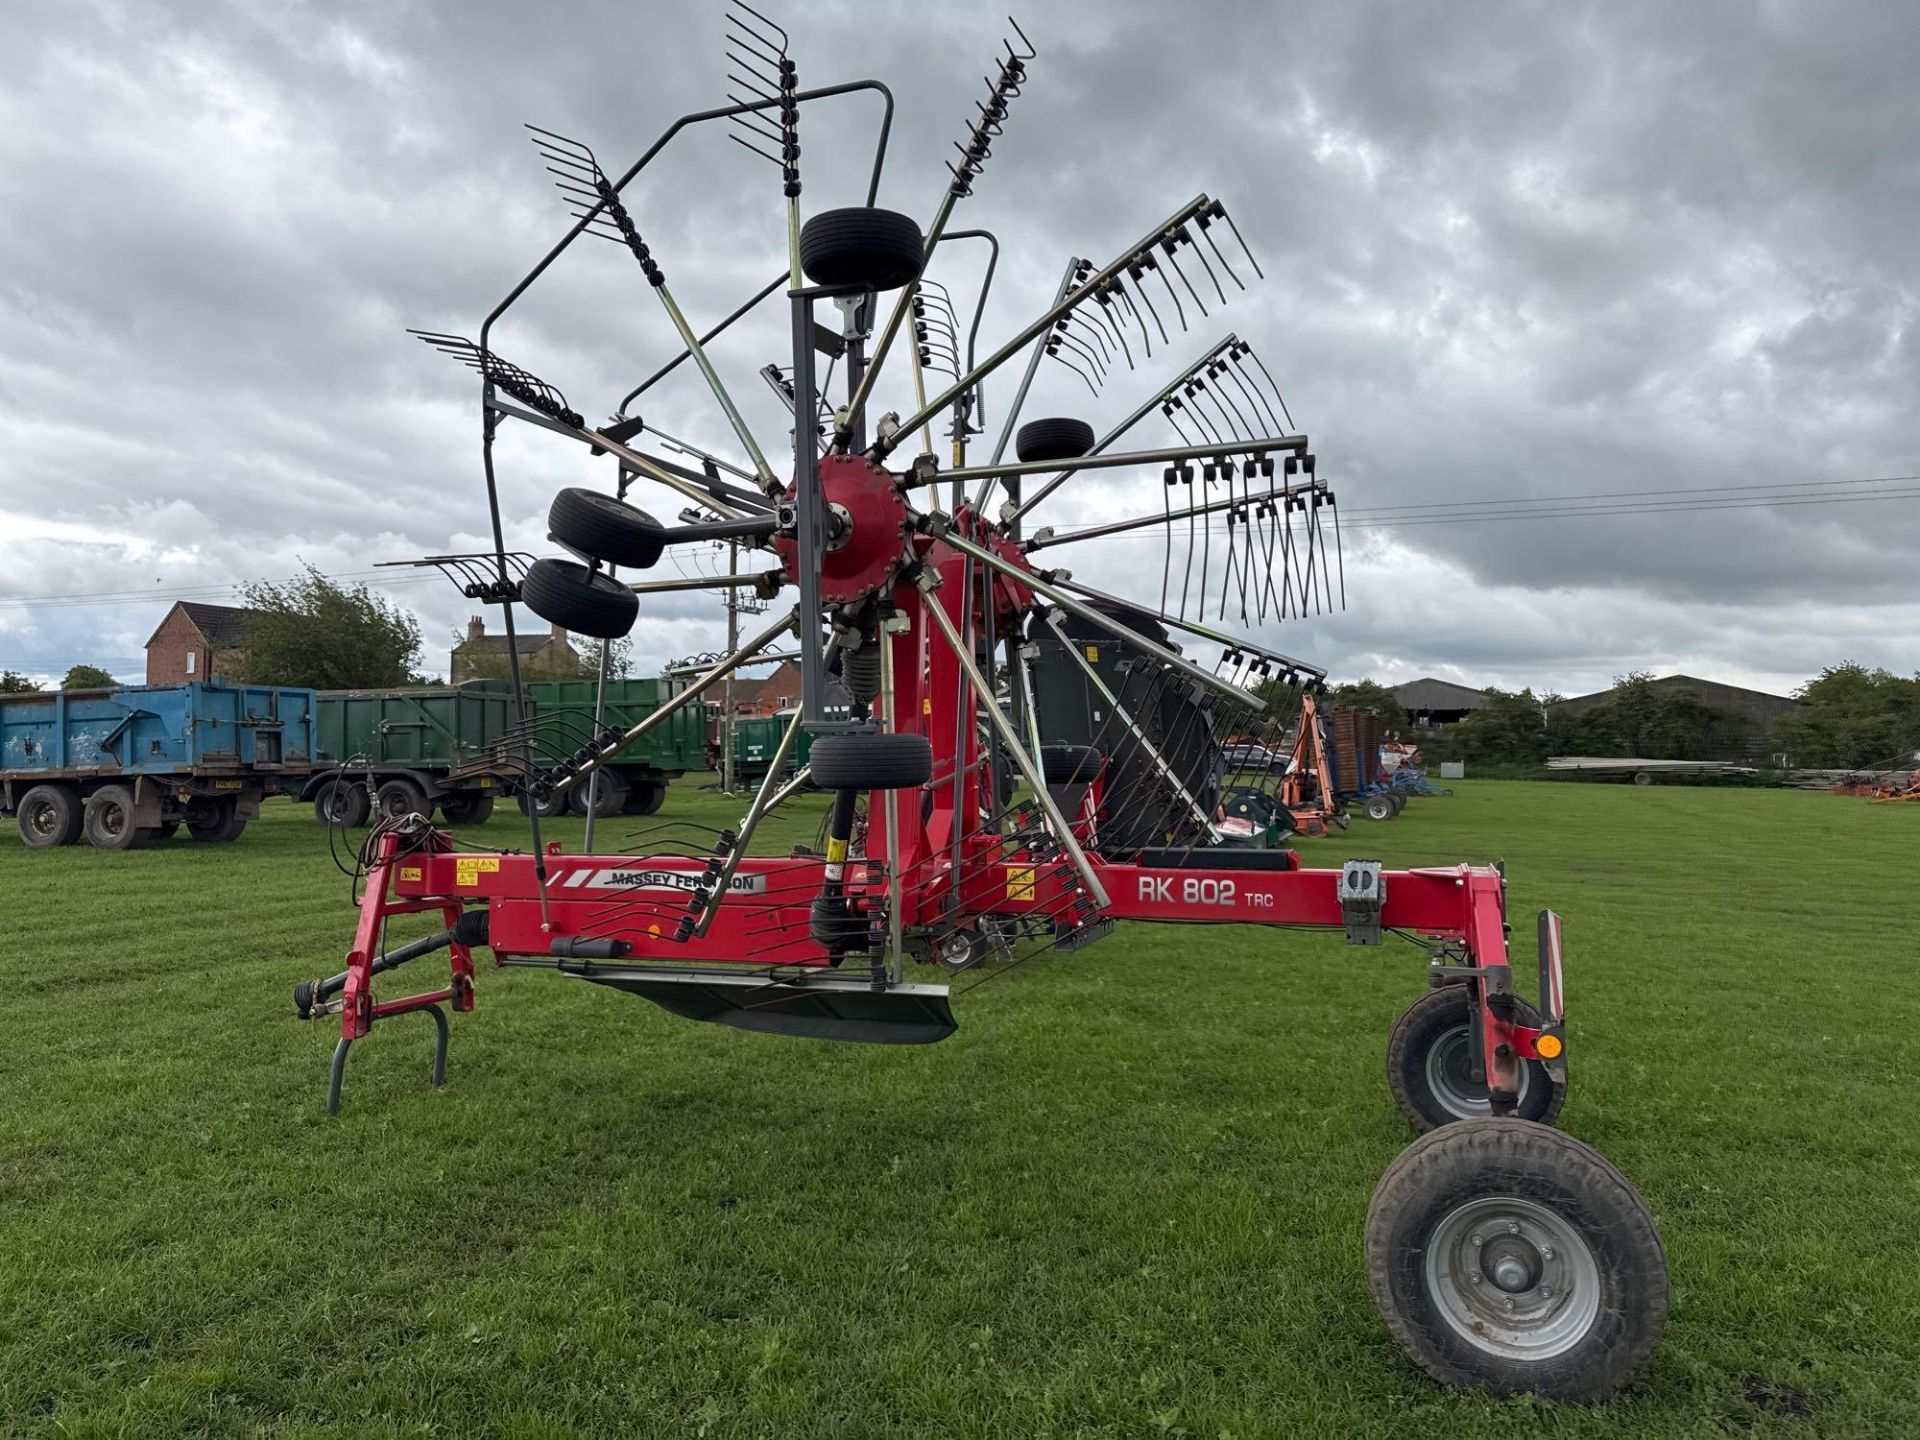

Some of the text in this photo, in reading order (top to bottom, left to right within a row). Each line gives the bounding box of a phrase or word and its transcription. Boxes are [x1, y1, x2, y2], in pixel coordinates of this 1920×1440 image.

[612, 872, 671, 885] MASSEY
[1138, 876, 1274, 908] RK 802 TRC
